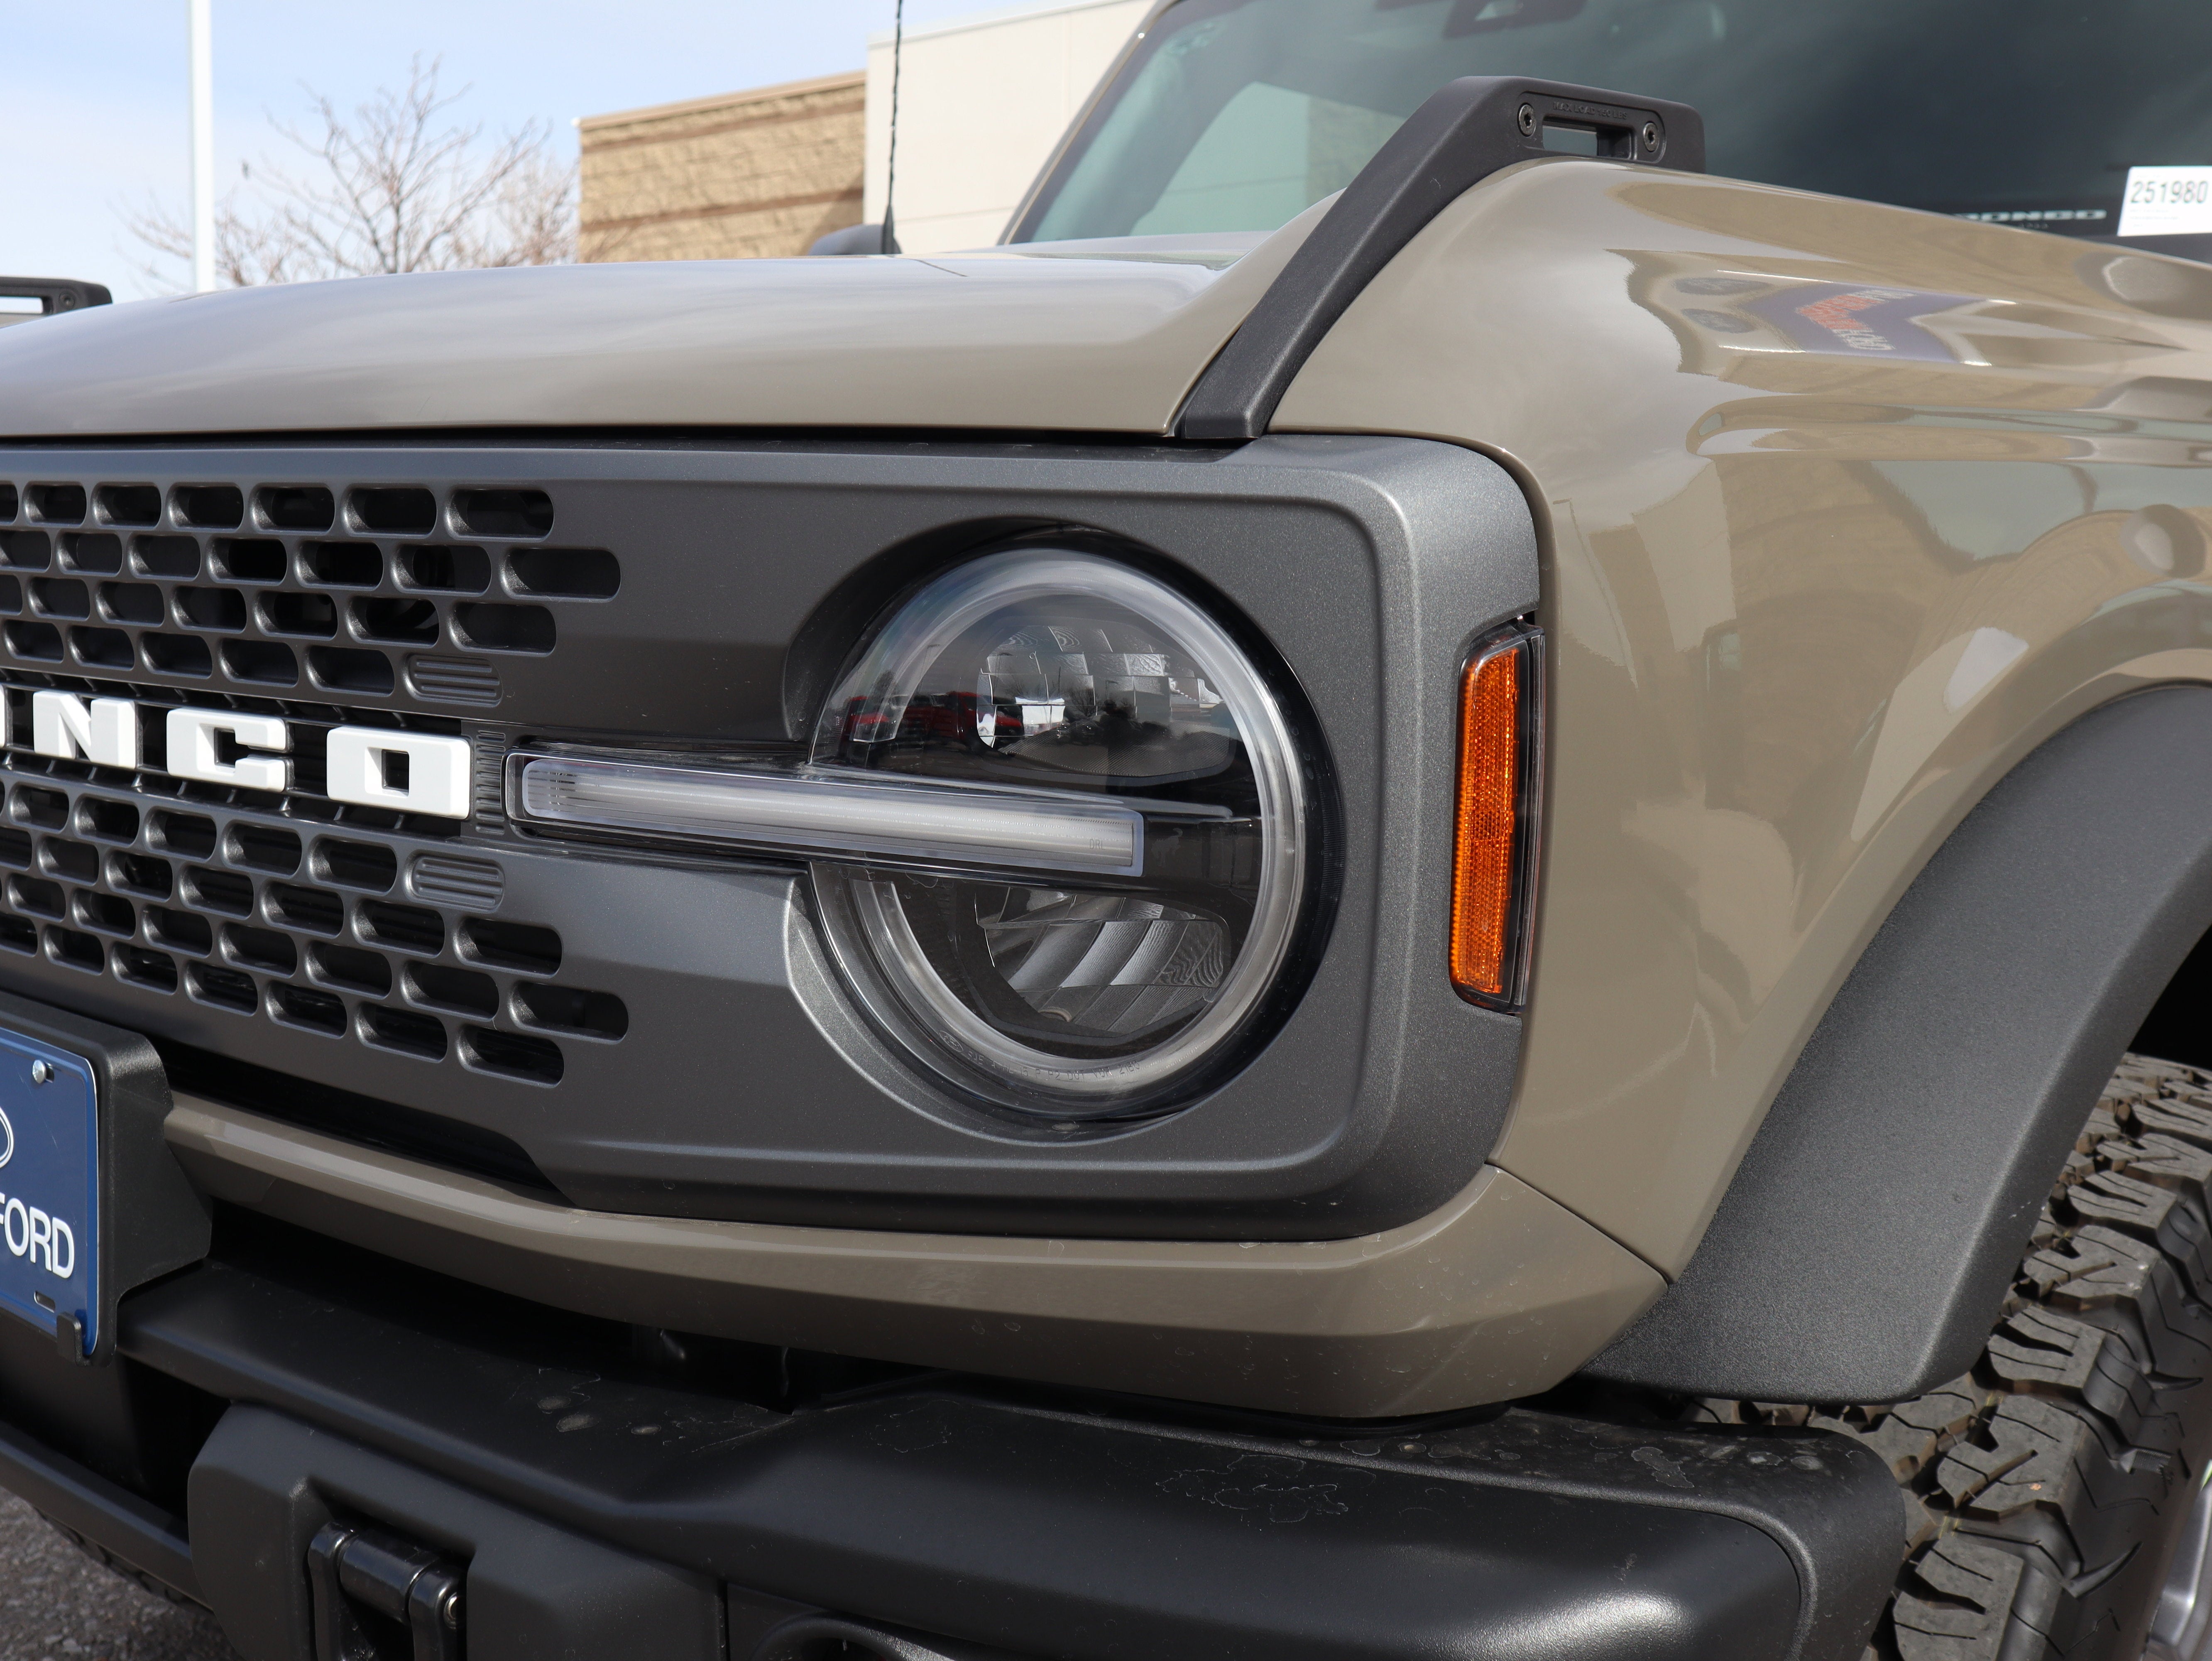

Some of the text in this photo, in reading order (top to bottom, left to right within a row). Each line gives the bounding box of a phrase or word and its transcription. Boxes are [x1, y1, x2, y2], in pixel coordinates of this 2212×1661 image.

[1554, 101, 1572, 112] MAX
[1574, 105, 1595, 115] LOAD
[1613, 110, 1628, 120] LBS
[2130, 180, 2208, 203] 251980
[0, 684, 470, 820] NCO
[1089, 839, 1105, 850] DRL
[1035, 1069, 1041, 1078] P
[1048, 1070, 1060, 1080] P2
[1067, 1070, 1085, 1080] DOT
